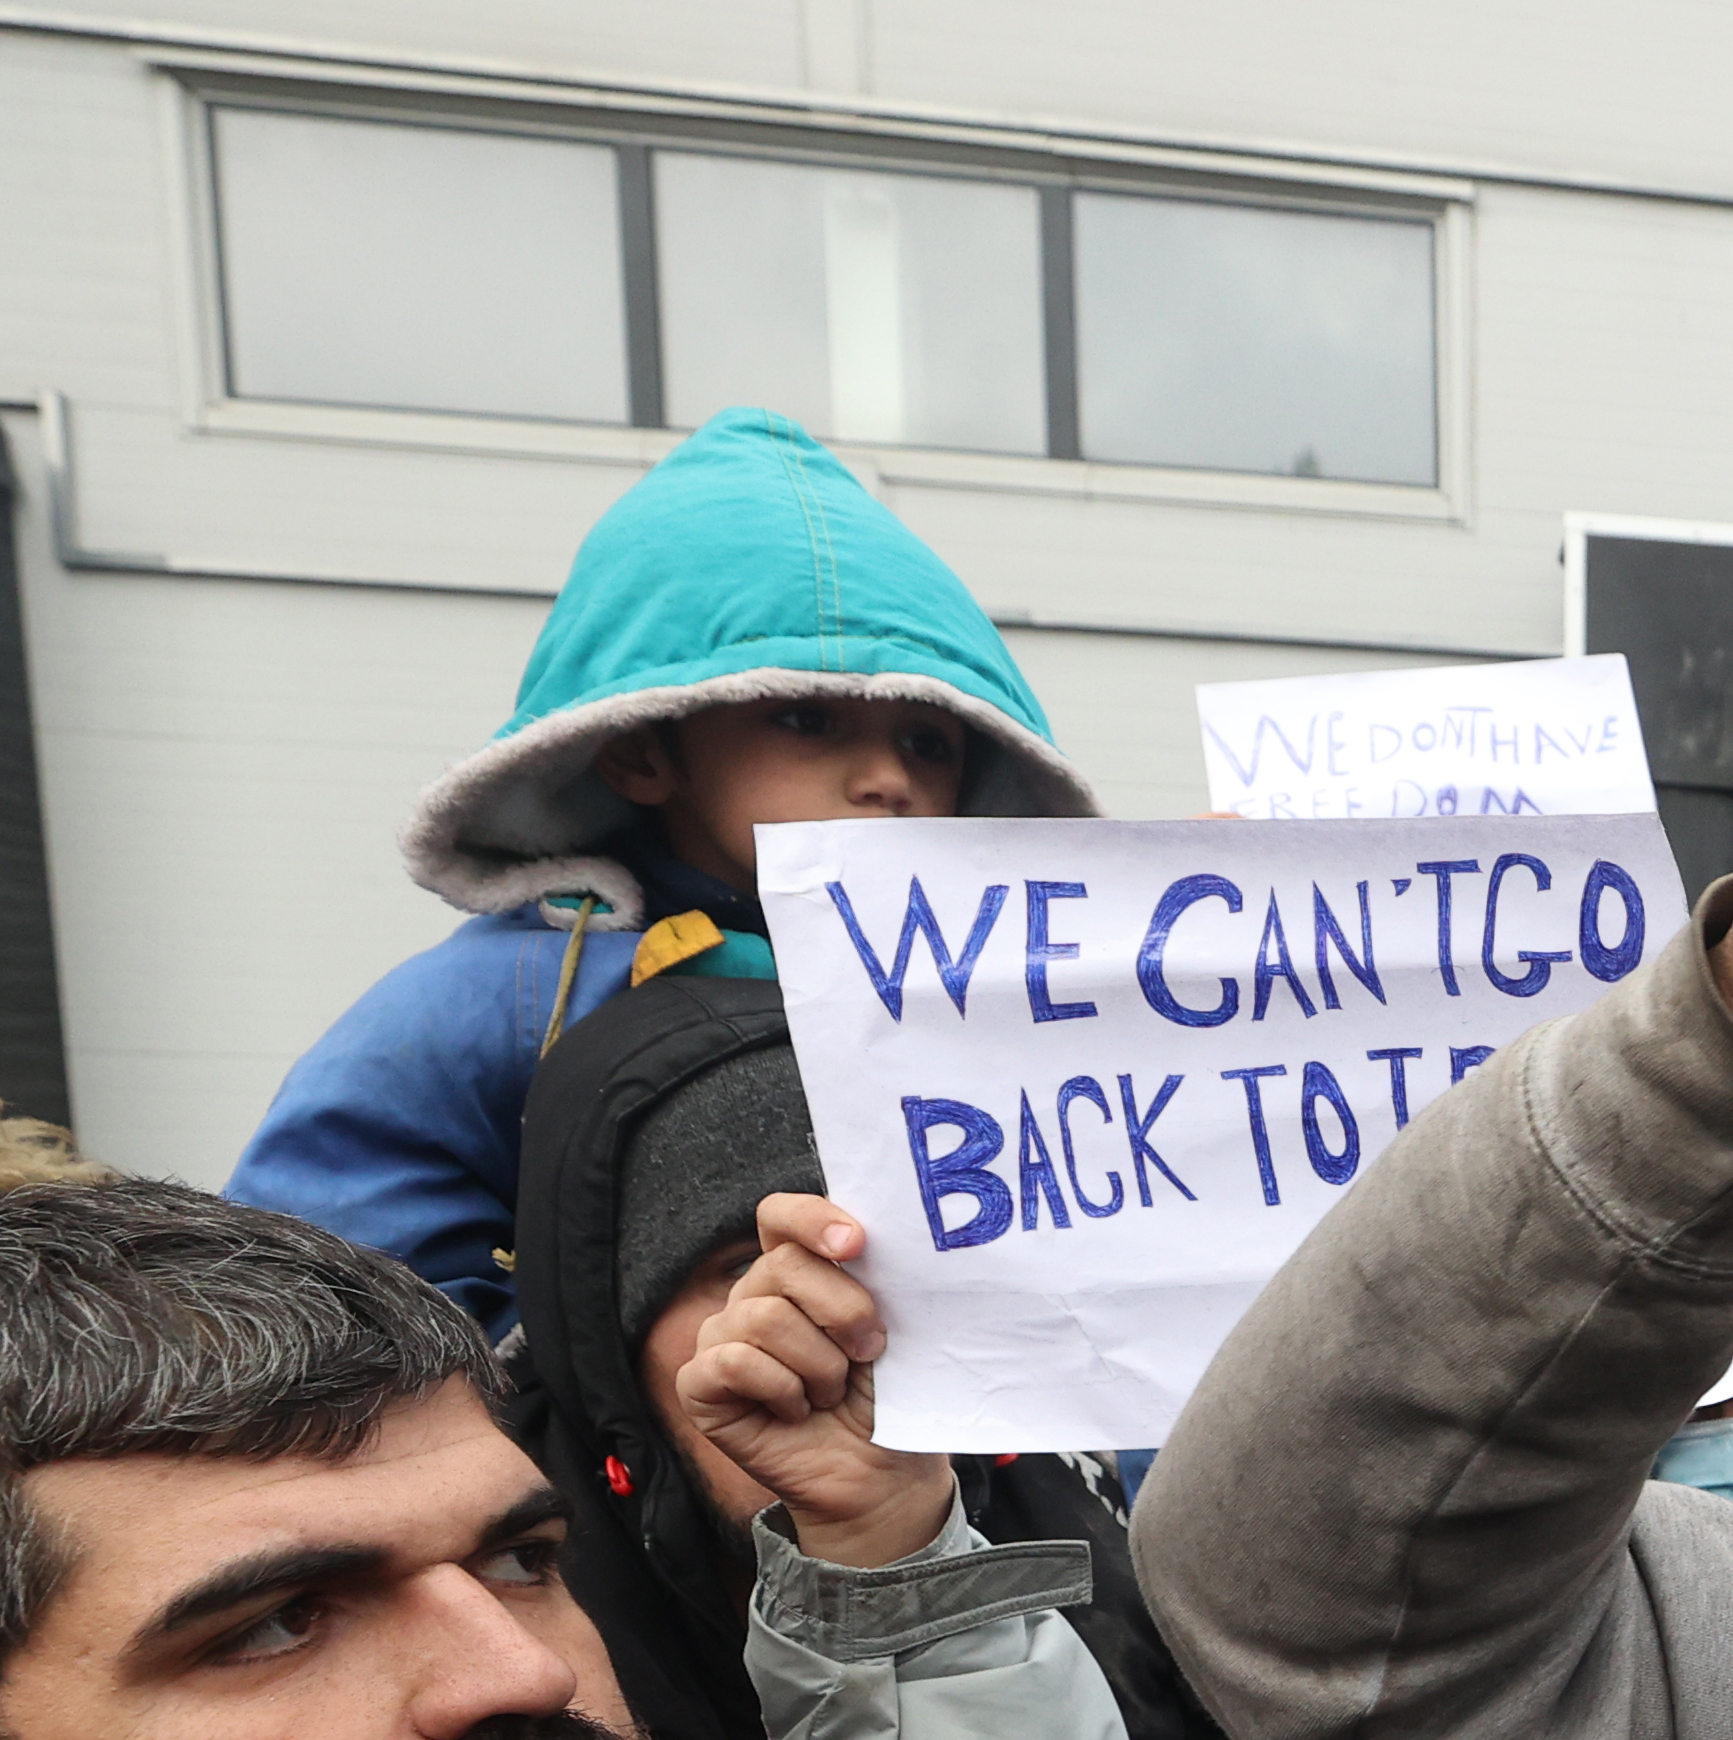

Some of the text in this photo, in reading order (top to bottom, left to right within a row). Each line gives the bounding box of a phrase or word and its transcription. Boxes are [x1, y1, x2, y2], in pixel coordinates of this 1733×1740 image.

[1200, 711, 1350, 788] WE
[827, 875, 1097, 1025] WE
[901, 1072, 1199, 1252] BACK
